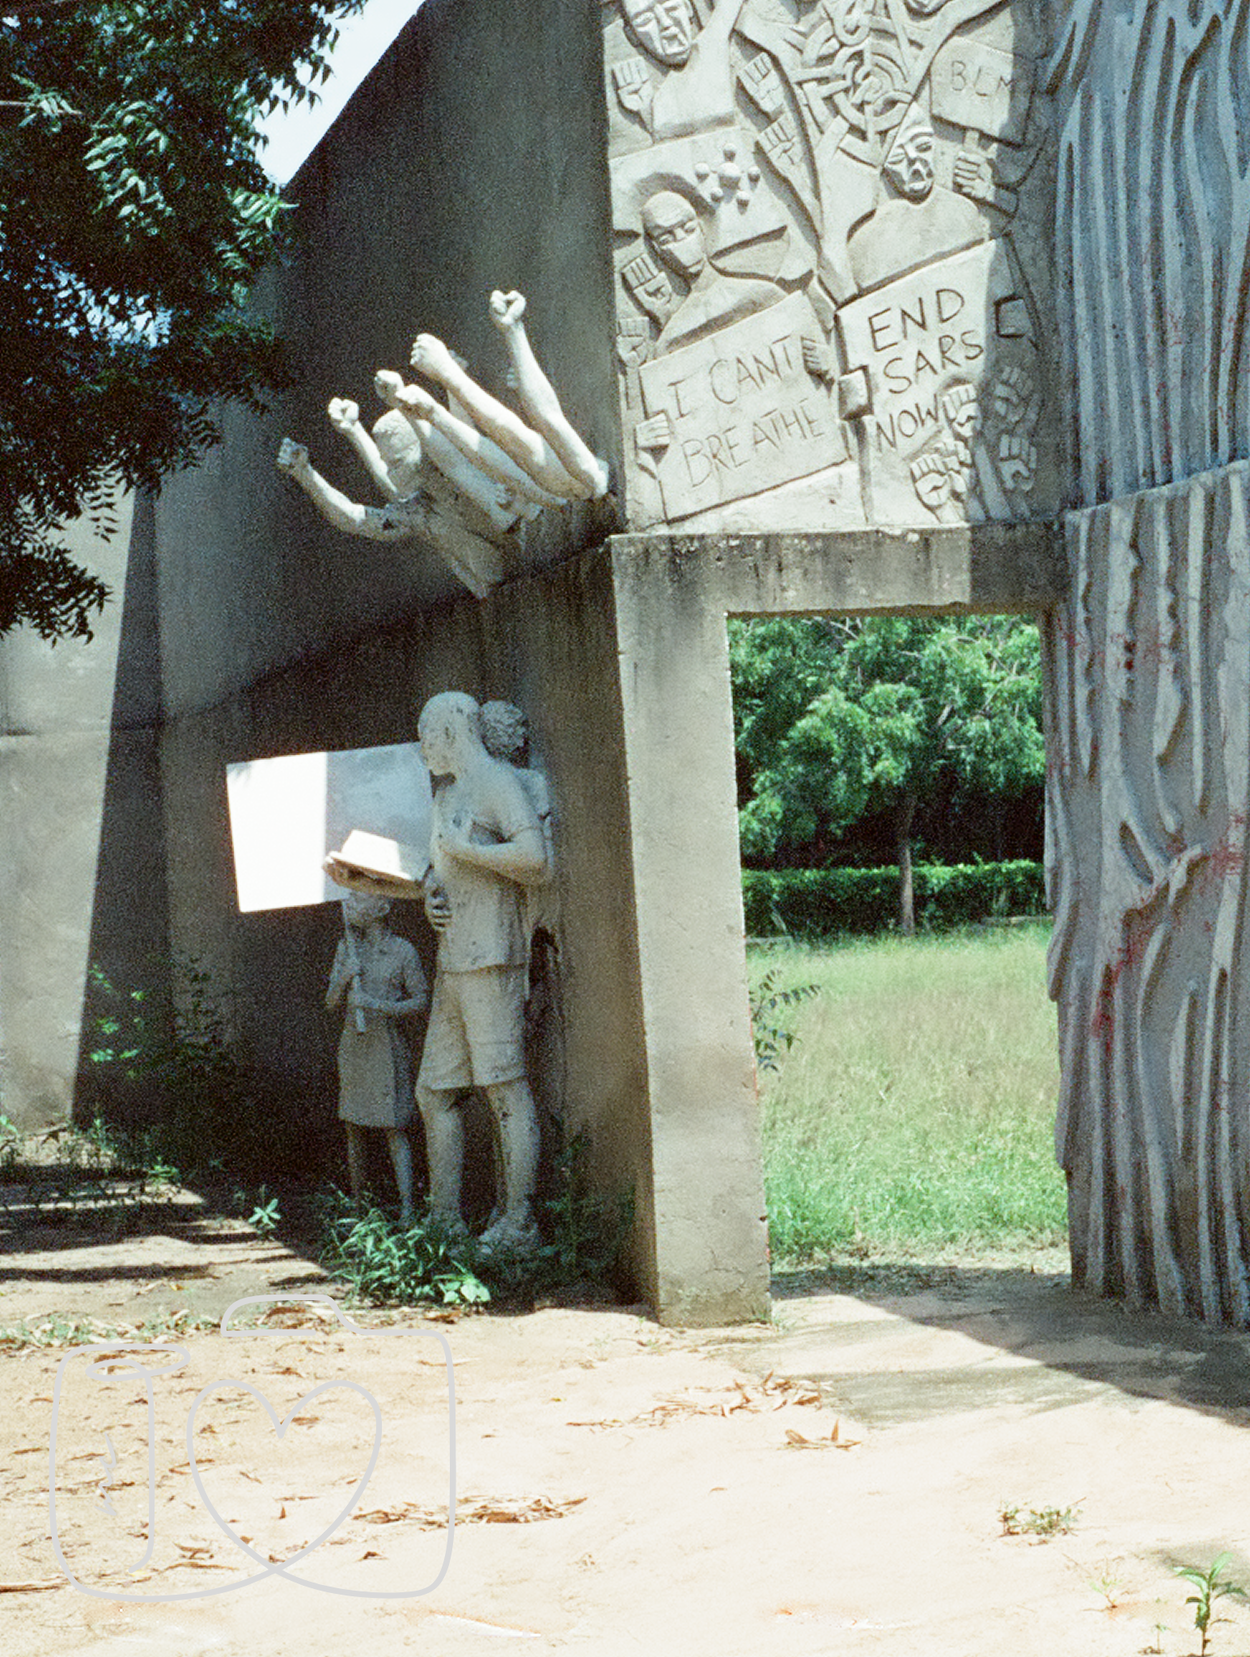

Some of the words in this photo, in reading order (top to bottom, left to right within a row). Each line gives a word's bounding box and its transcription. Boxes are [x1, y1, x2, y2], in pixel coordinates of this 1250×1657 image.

[868, 288, 966, 353] END
[667, 378, 693, 421] I
[708, 333, 793, 405] CANT
[883, 329, 985, 395] SARS
[680, 397, 826, 488] BREATHE
[875, 392, 940, 454] NOW
